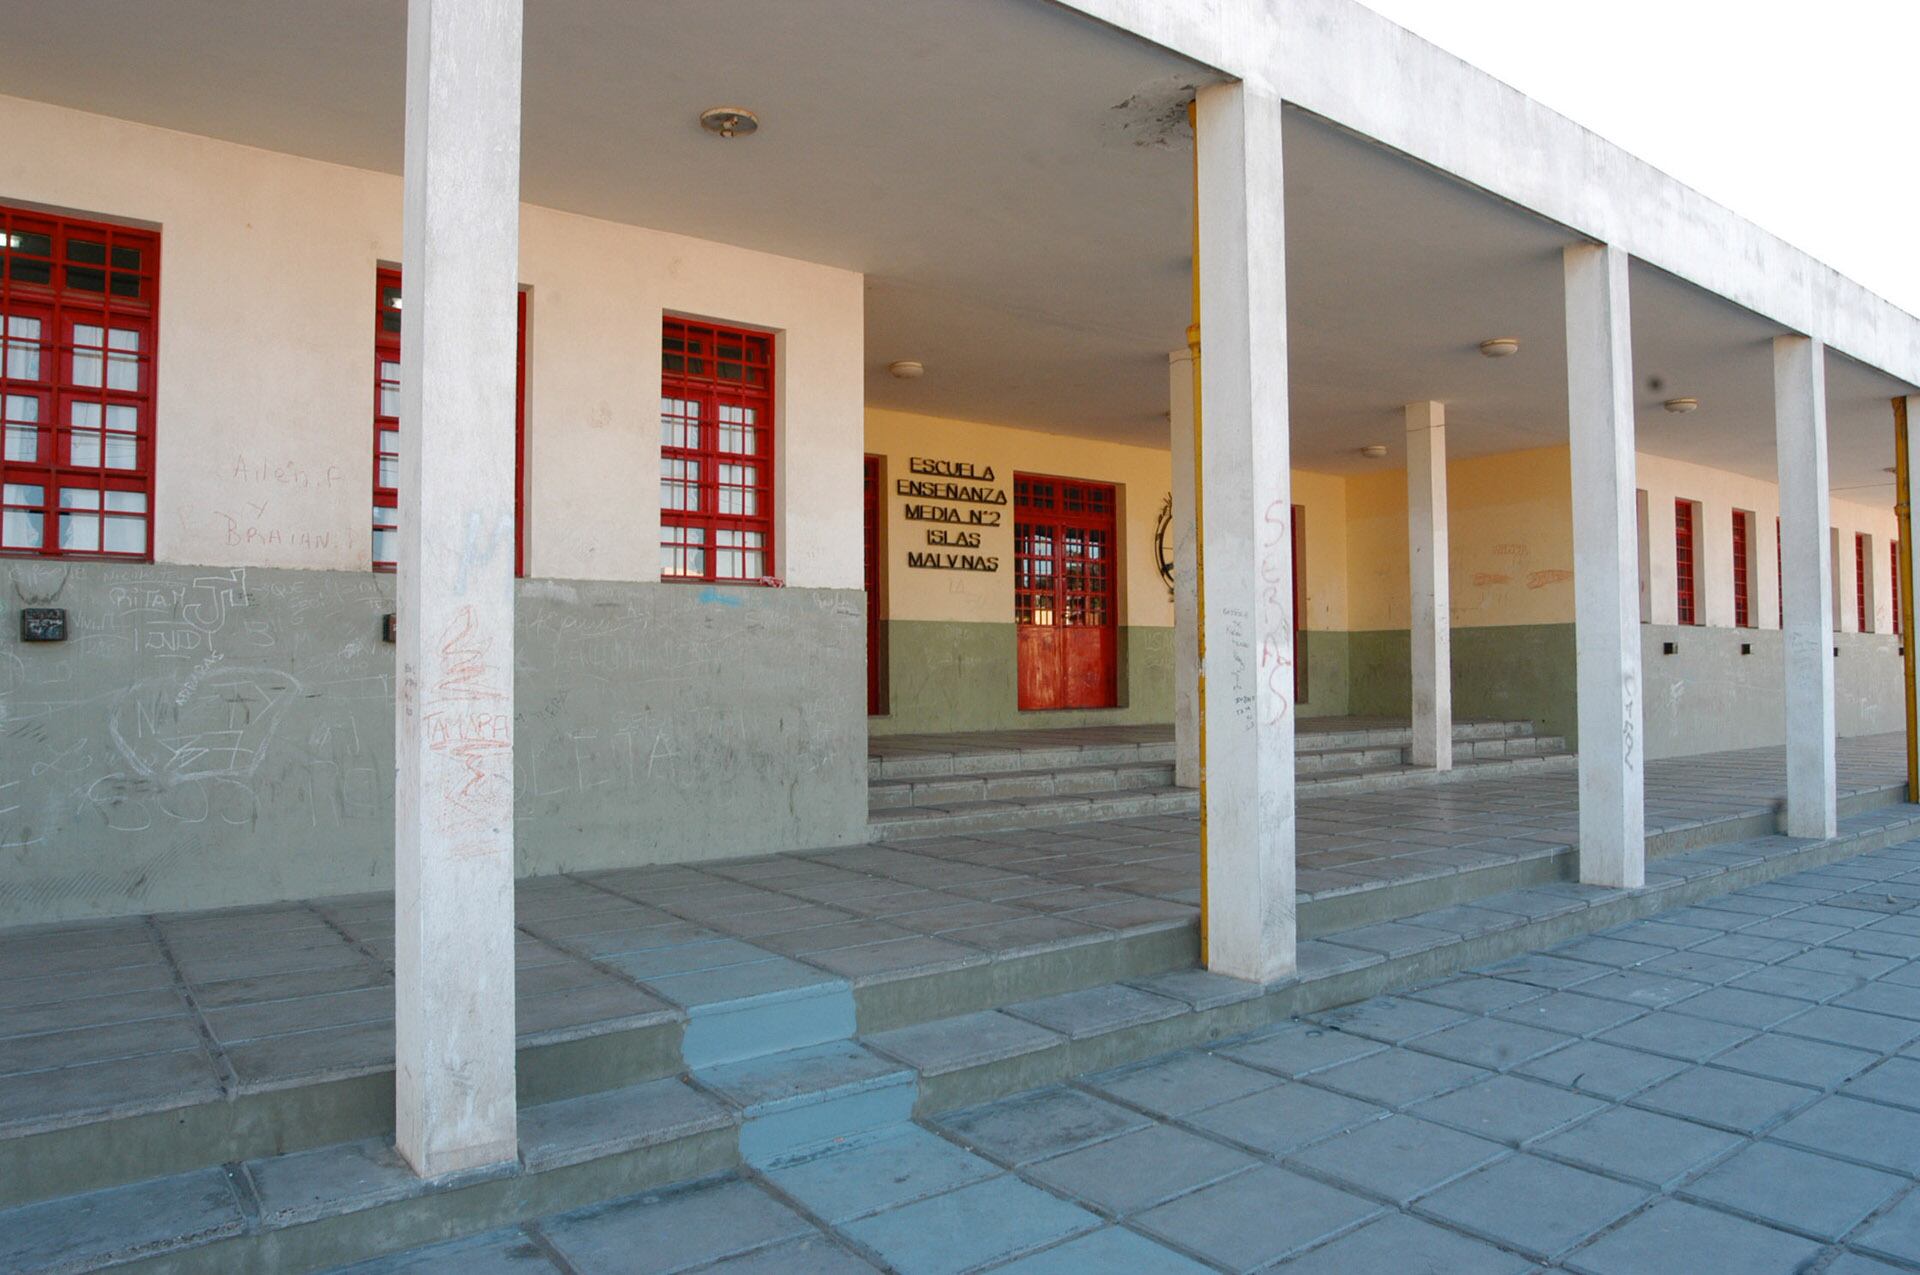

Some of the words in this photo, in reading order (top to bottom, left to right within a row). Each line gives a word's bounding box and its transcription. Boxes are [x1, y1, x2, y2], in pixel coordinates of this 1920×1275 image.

[910, 457, 995, 481] ESCUELA
[897, 479, 1008, 505] ENSEÑANZA
[905, 503, 960, 523] MEDIA
[927, 529, 981, 548] ISLAS
